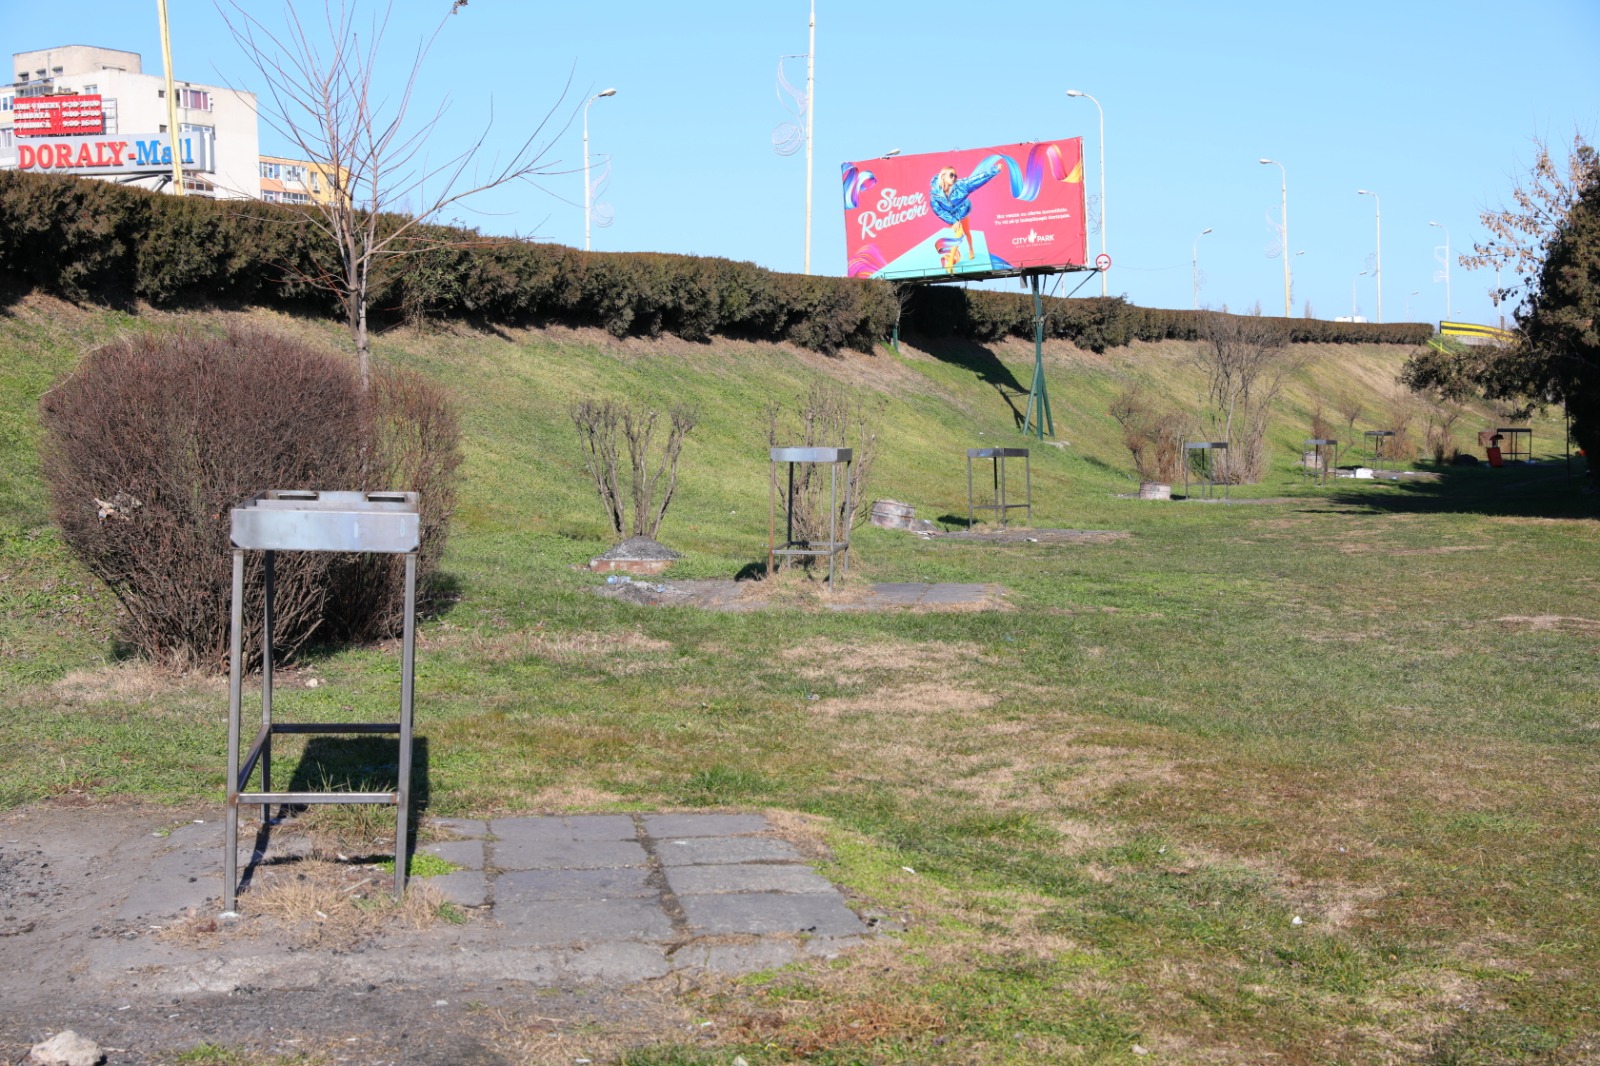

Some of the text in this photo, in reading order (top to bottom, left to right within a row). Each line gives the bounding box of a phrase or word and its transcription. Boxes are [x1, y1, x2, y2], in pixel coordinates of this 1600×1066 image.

[876, 187, 925, 212] Super
[857, 202, 928, 240] Reduceri
[1012, 237, 1027, 245] CITY
[1037, 234, 1055, 242] PARK
